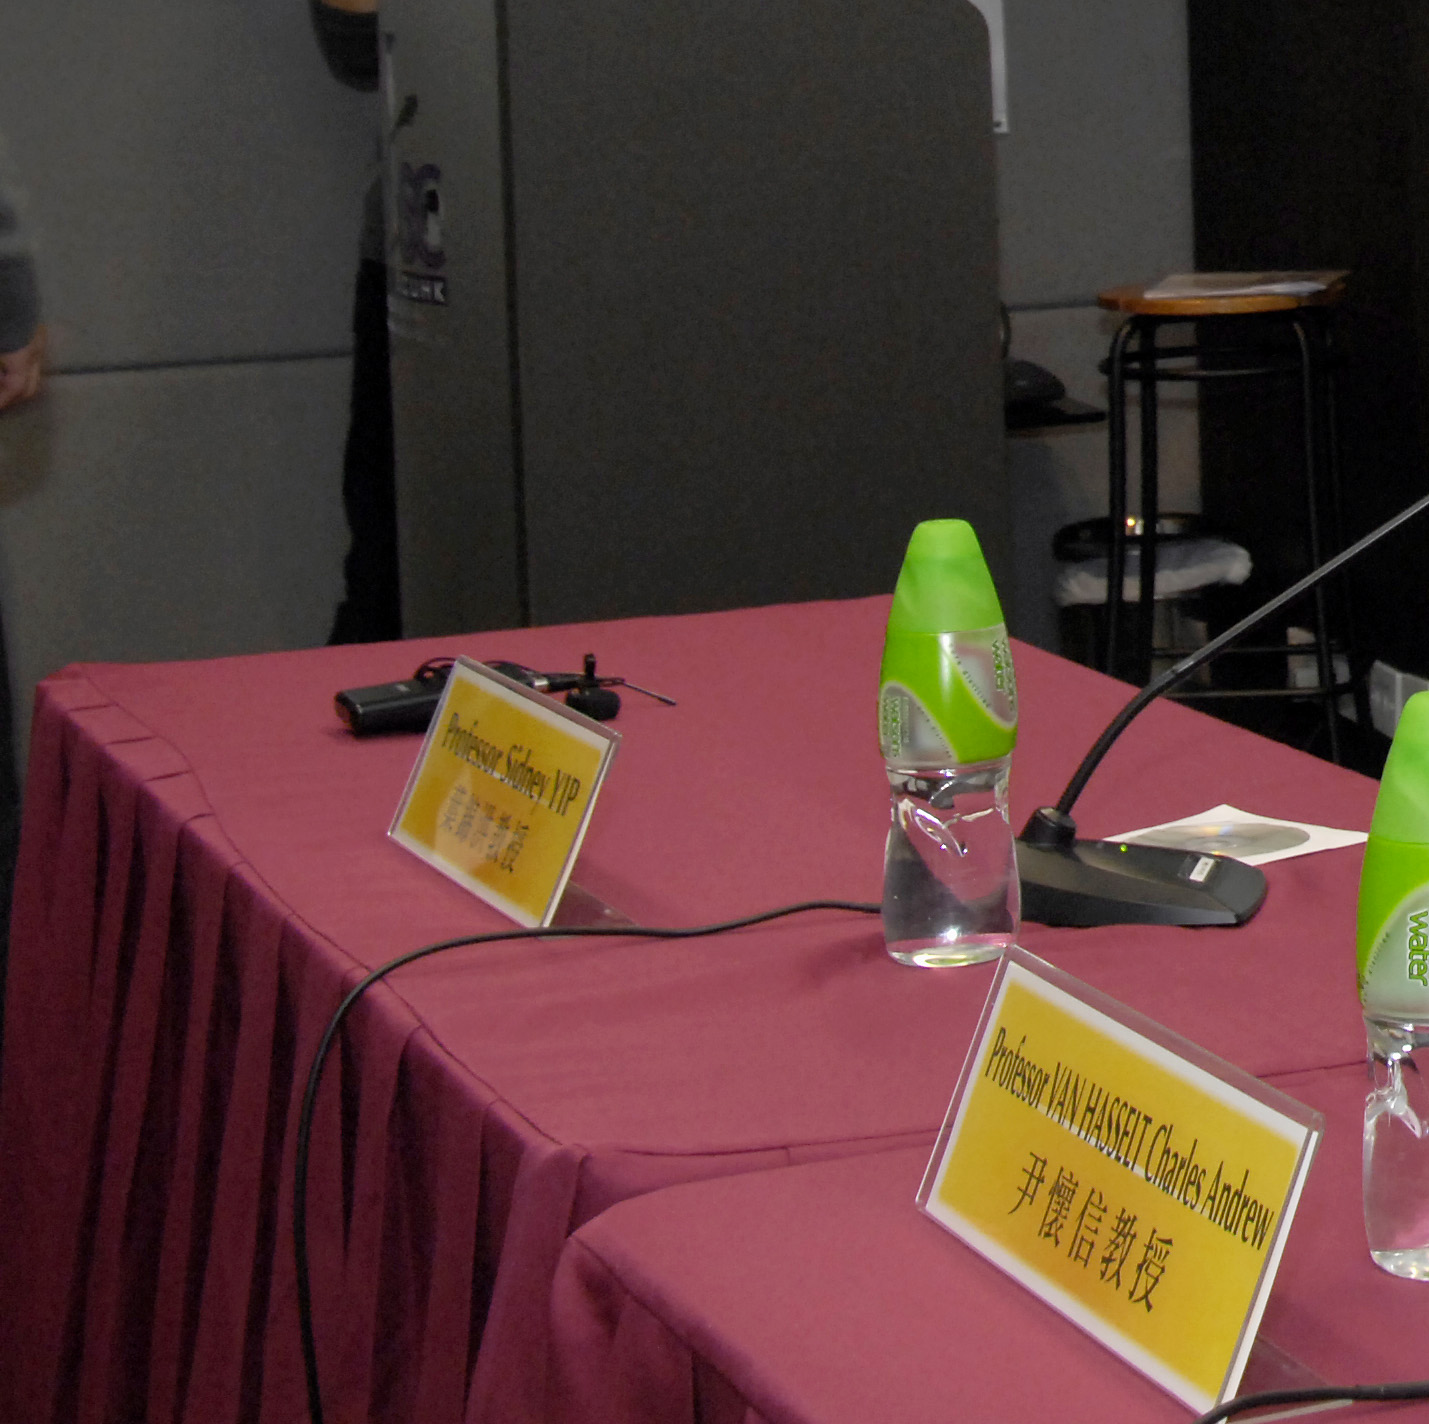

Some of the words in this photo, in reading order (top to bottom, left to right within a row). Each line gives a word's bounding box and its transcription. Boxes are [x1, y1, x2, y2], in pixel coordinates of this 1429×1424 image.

[442, 712, 503, 776] Professor
[499, 743, 550, 816] Sidney
[548, 768, 581, 817] YIP
[985, 1026, 1051, 1110] Professor
[1045, 1061, 1087, 1131] VAN
[1076, 1082, 1153, 1172] HASSELT
[1144, 1123, 1207, 1211] Charles
[1200, 1160, 1275, 1251] Andrew
[1008, 1151, 1175, 1313] 尹懷信教授
